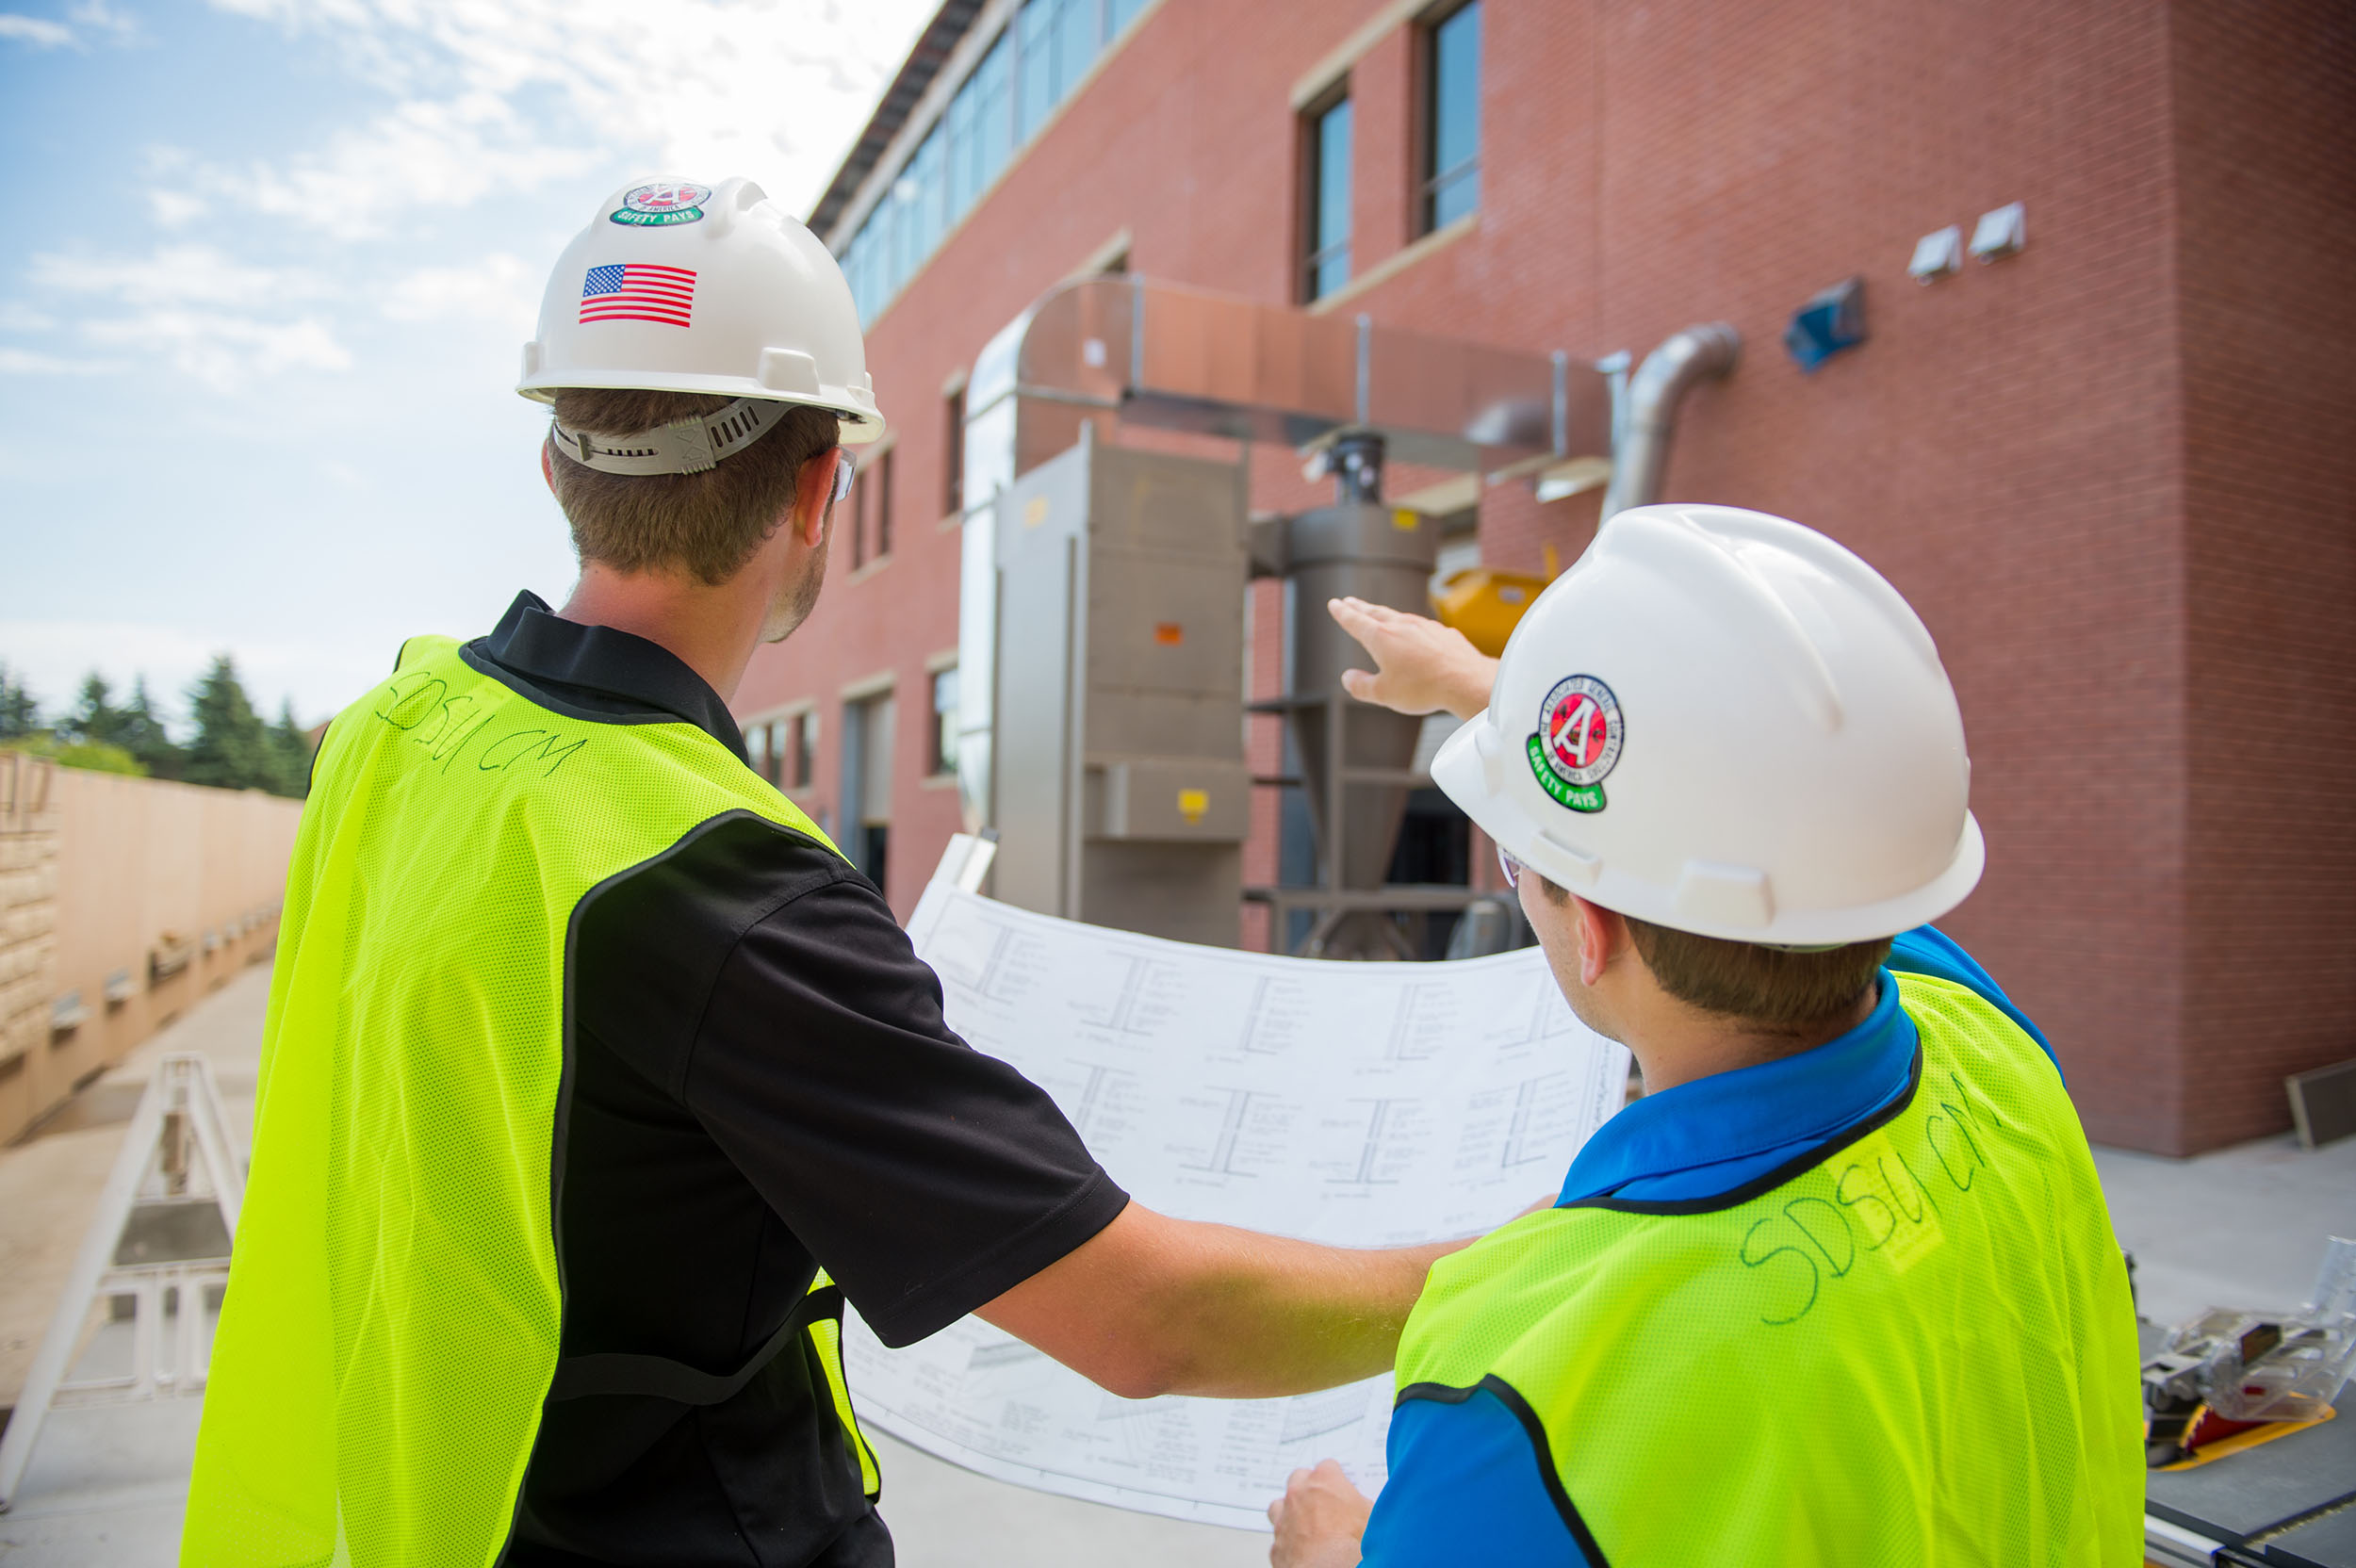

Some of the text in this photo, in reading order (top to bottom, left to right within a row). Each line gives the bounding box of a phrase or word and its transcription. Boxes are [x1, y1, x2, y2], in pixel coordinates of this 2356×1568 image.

[617, 210, 695, 223] SAFETY PAYS
[479, 729, 588, 777] CM
[1552, 697, 1597, 766] A
[1530, 745, 1599, 808] SAFETY PAYS
[1740, 1071, 2002, 1326] SDSU CM
